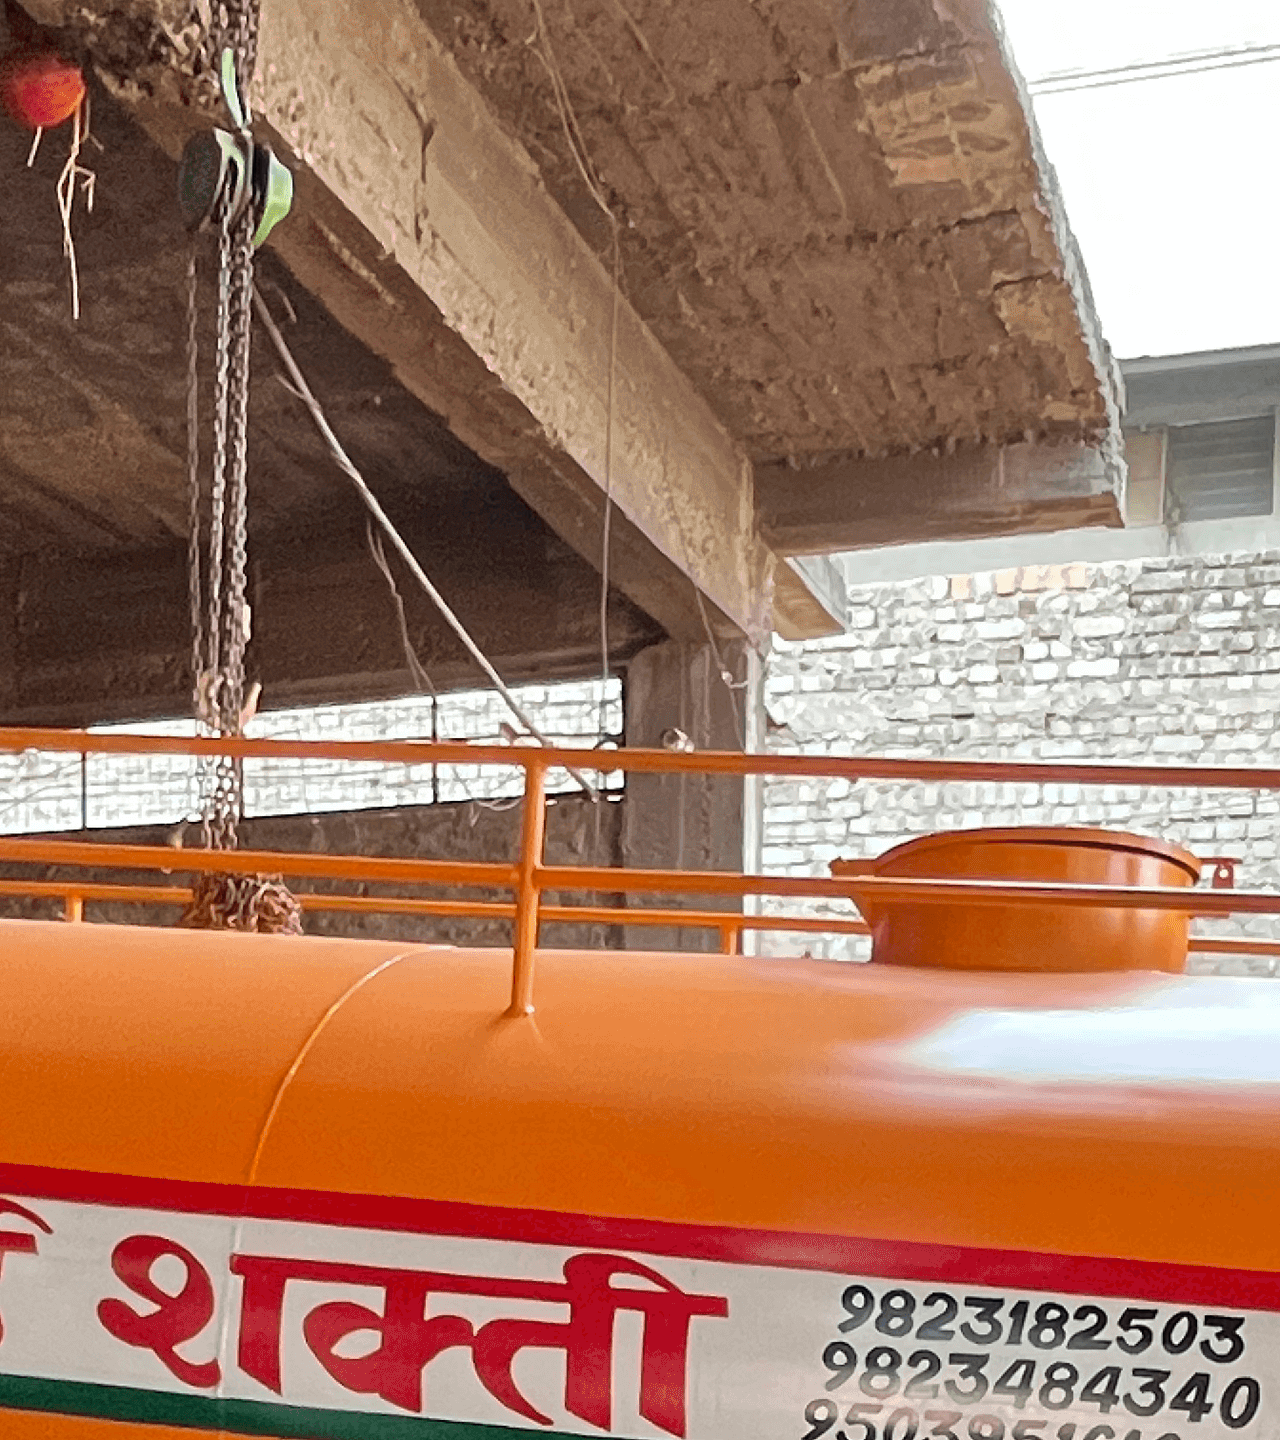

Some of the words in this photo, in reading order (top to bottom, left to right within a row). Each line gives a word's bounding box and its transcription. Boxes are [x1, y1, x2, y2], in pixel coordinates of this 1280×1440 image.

[96, 1234, 728, 1437] शक्ती
[838, 1284, 1246, 1364] 9823182503
[822, 1341, 1260, 1429] 9823484340
